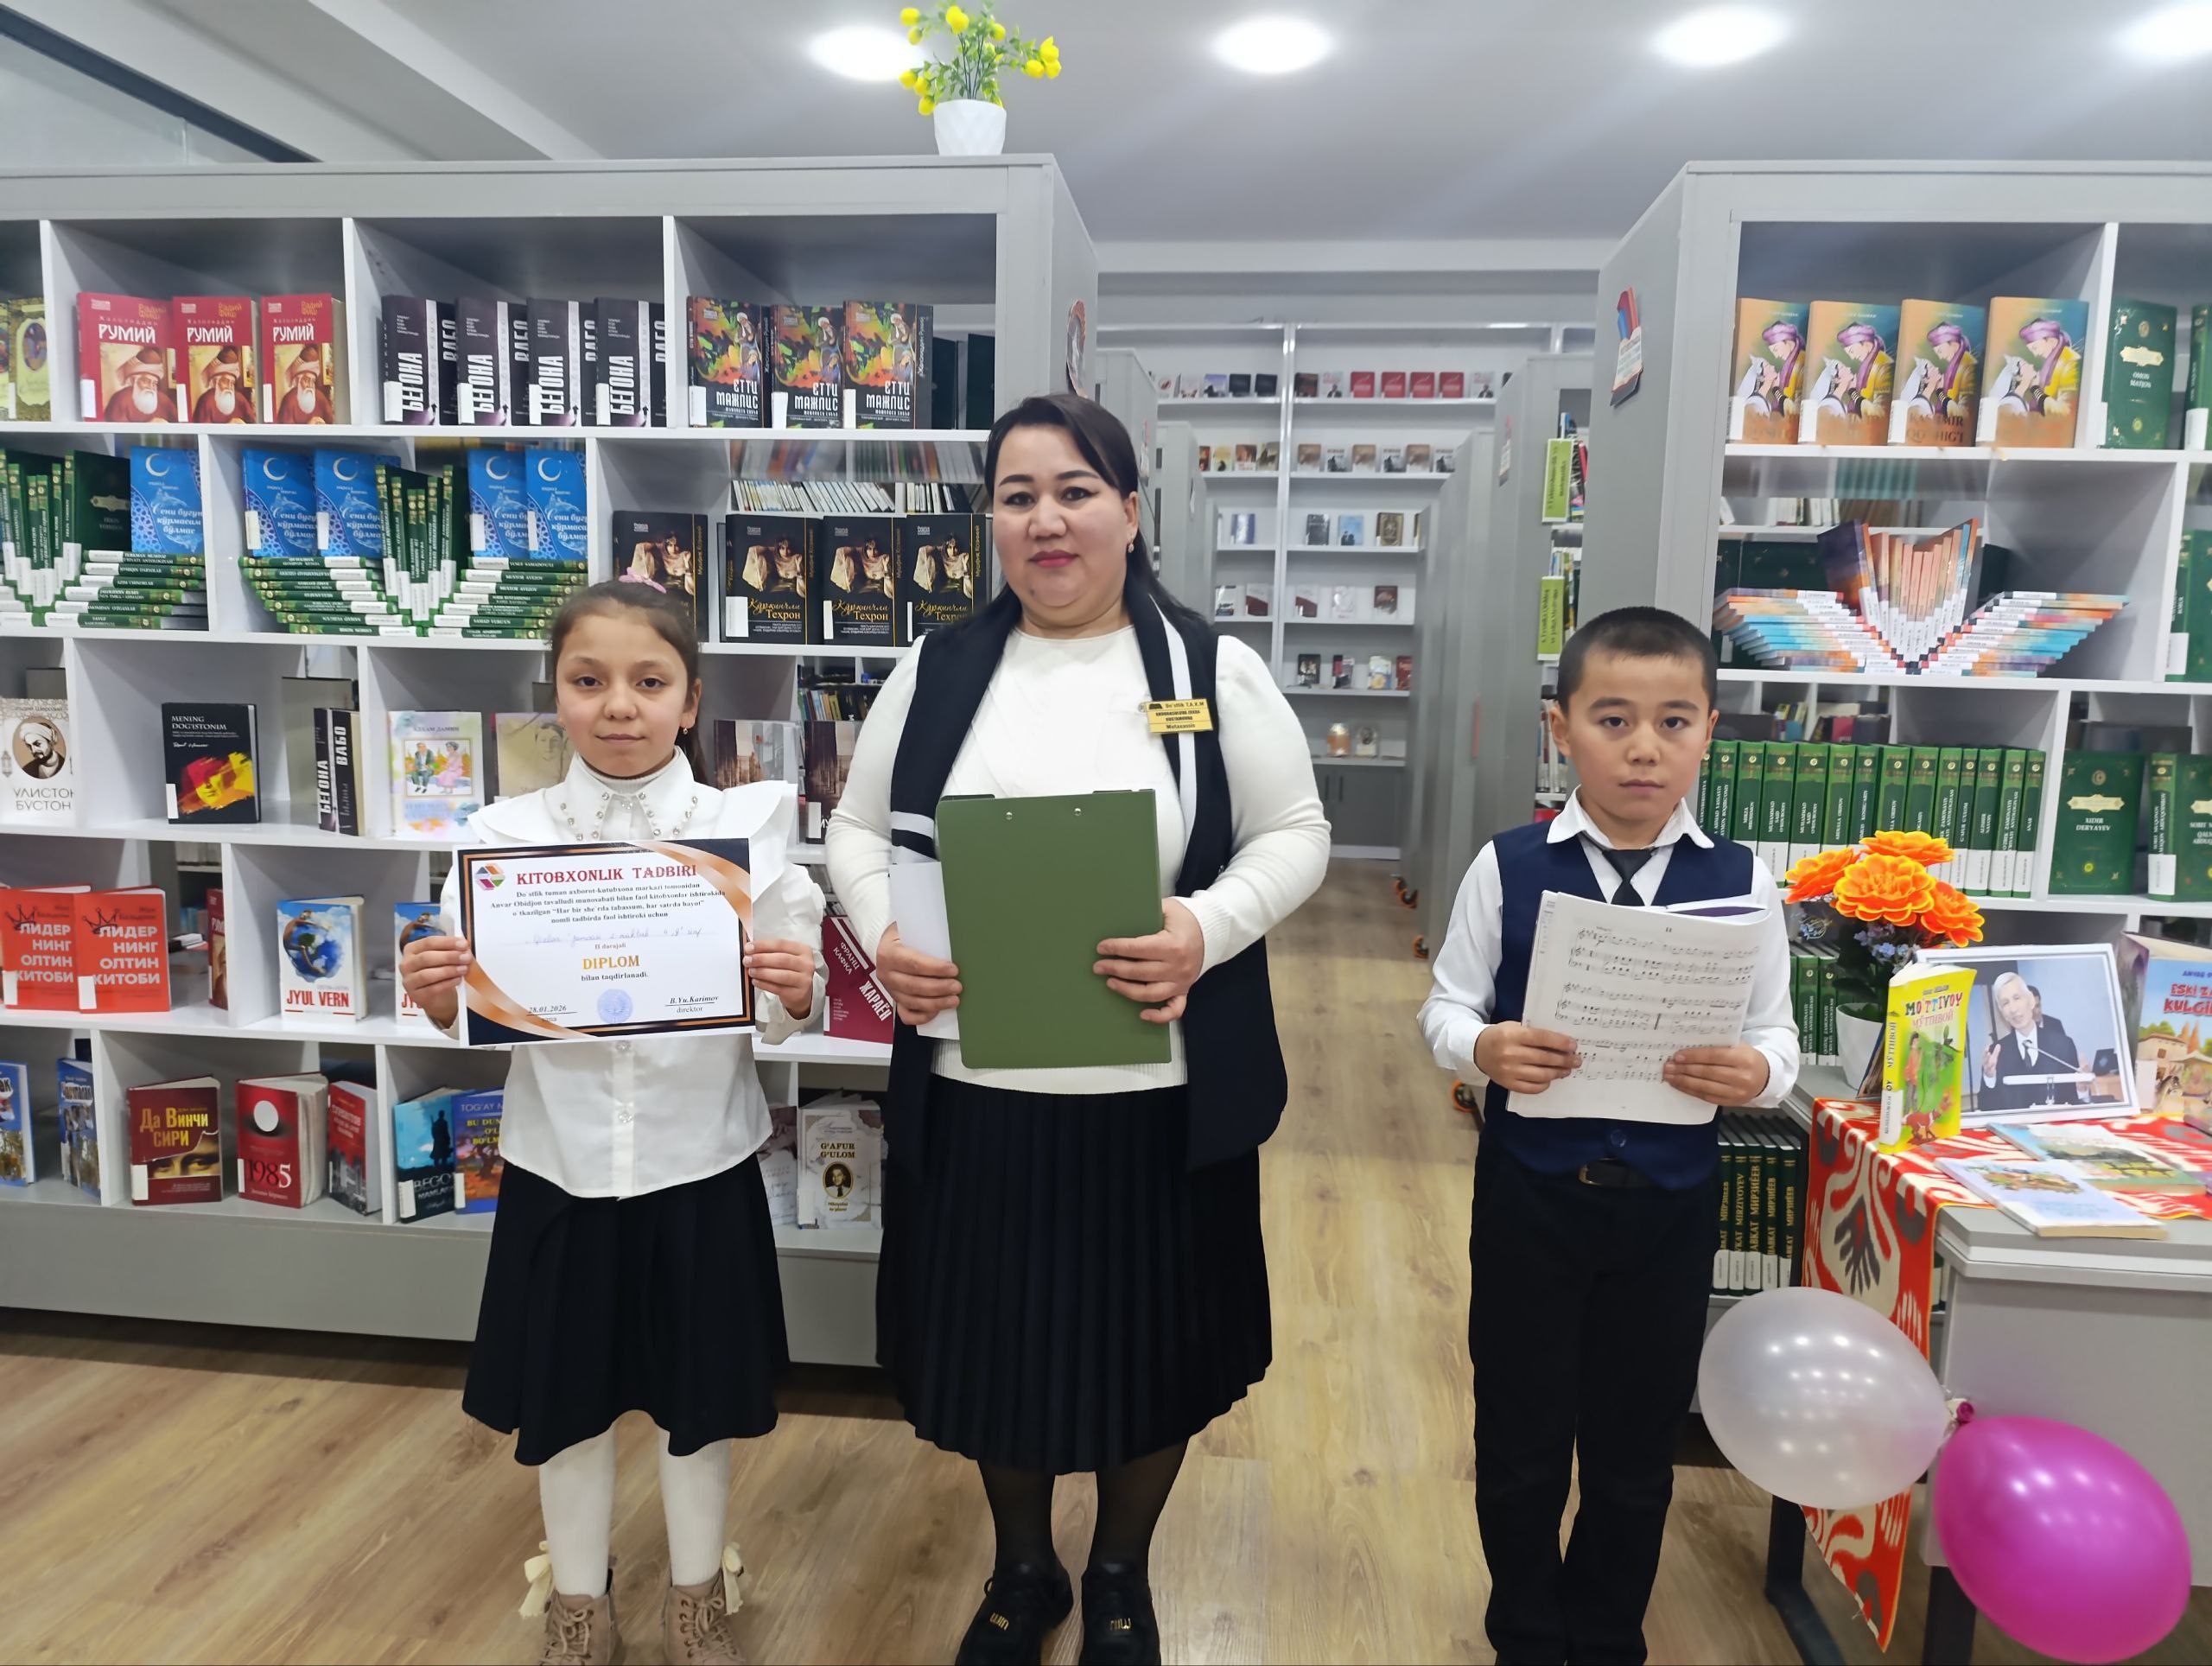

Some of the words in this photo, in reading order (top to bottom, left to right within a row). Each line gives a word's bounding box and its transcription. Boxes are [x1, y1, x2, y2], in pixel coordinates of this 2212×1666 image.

[99, 323, 156, 343] РУМИЙ
[187, 325, 232, 342] РУМИЙ
[273, 323, 315, 342] РУМИЙ
[16, 801, 71, 811] БУСТОН
[517, 868, 624, 885] KITOBXONLIK
[632, 864, 697, 879] TADBIRI
[20, 922, 71, 936] ЛИДЕР
[99, 925, 158, 938] ЛИДЕР
[32, 939, 72, 951] НИНГ
[113, 941, 158, 953] НИНГ
[602, 942, 626, 951] darajali
[21, 954, 73, 967] ОЛТИН
[99, 957, 159, 969] ОЛТИН
[582, 955, 640, 970] DIPLOM
[832, 946, 853, 976] КАФКА
[840, 942, 860, 970] ФРАНЦ
[601, 971, 649, 982] taqdirlanadi.
[287, 989, 314, 1006] JYUL
[319, 991, 349, 1008] VERN
[2171, 983, 2197, 997] ESKI
[859, 980, 893, 1021] ЖАРАЁН
[2164, 998, 2212, 1017] KULGI
[140, 1108, 160, 1132] Да
[249, 1159, 292, 1189] 1985
[1735, 1173, 1745, 1225] MIRZIYOYEV
[1750, 1165, 1760, 1215] МИРЗИЁЕВ
[1767, 1177, 1777, 1218] МИРЗИЁЕВ
